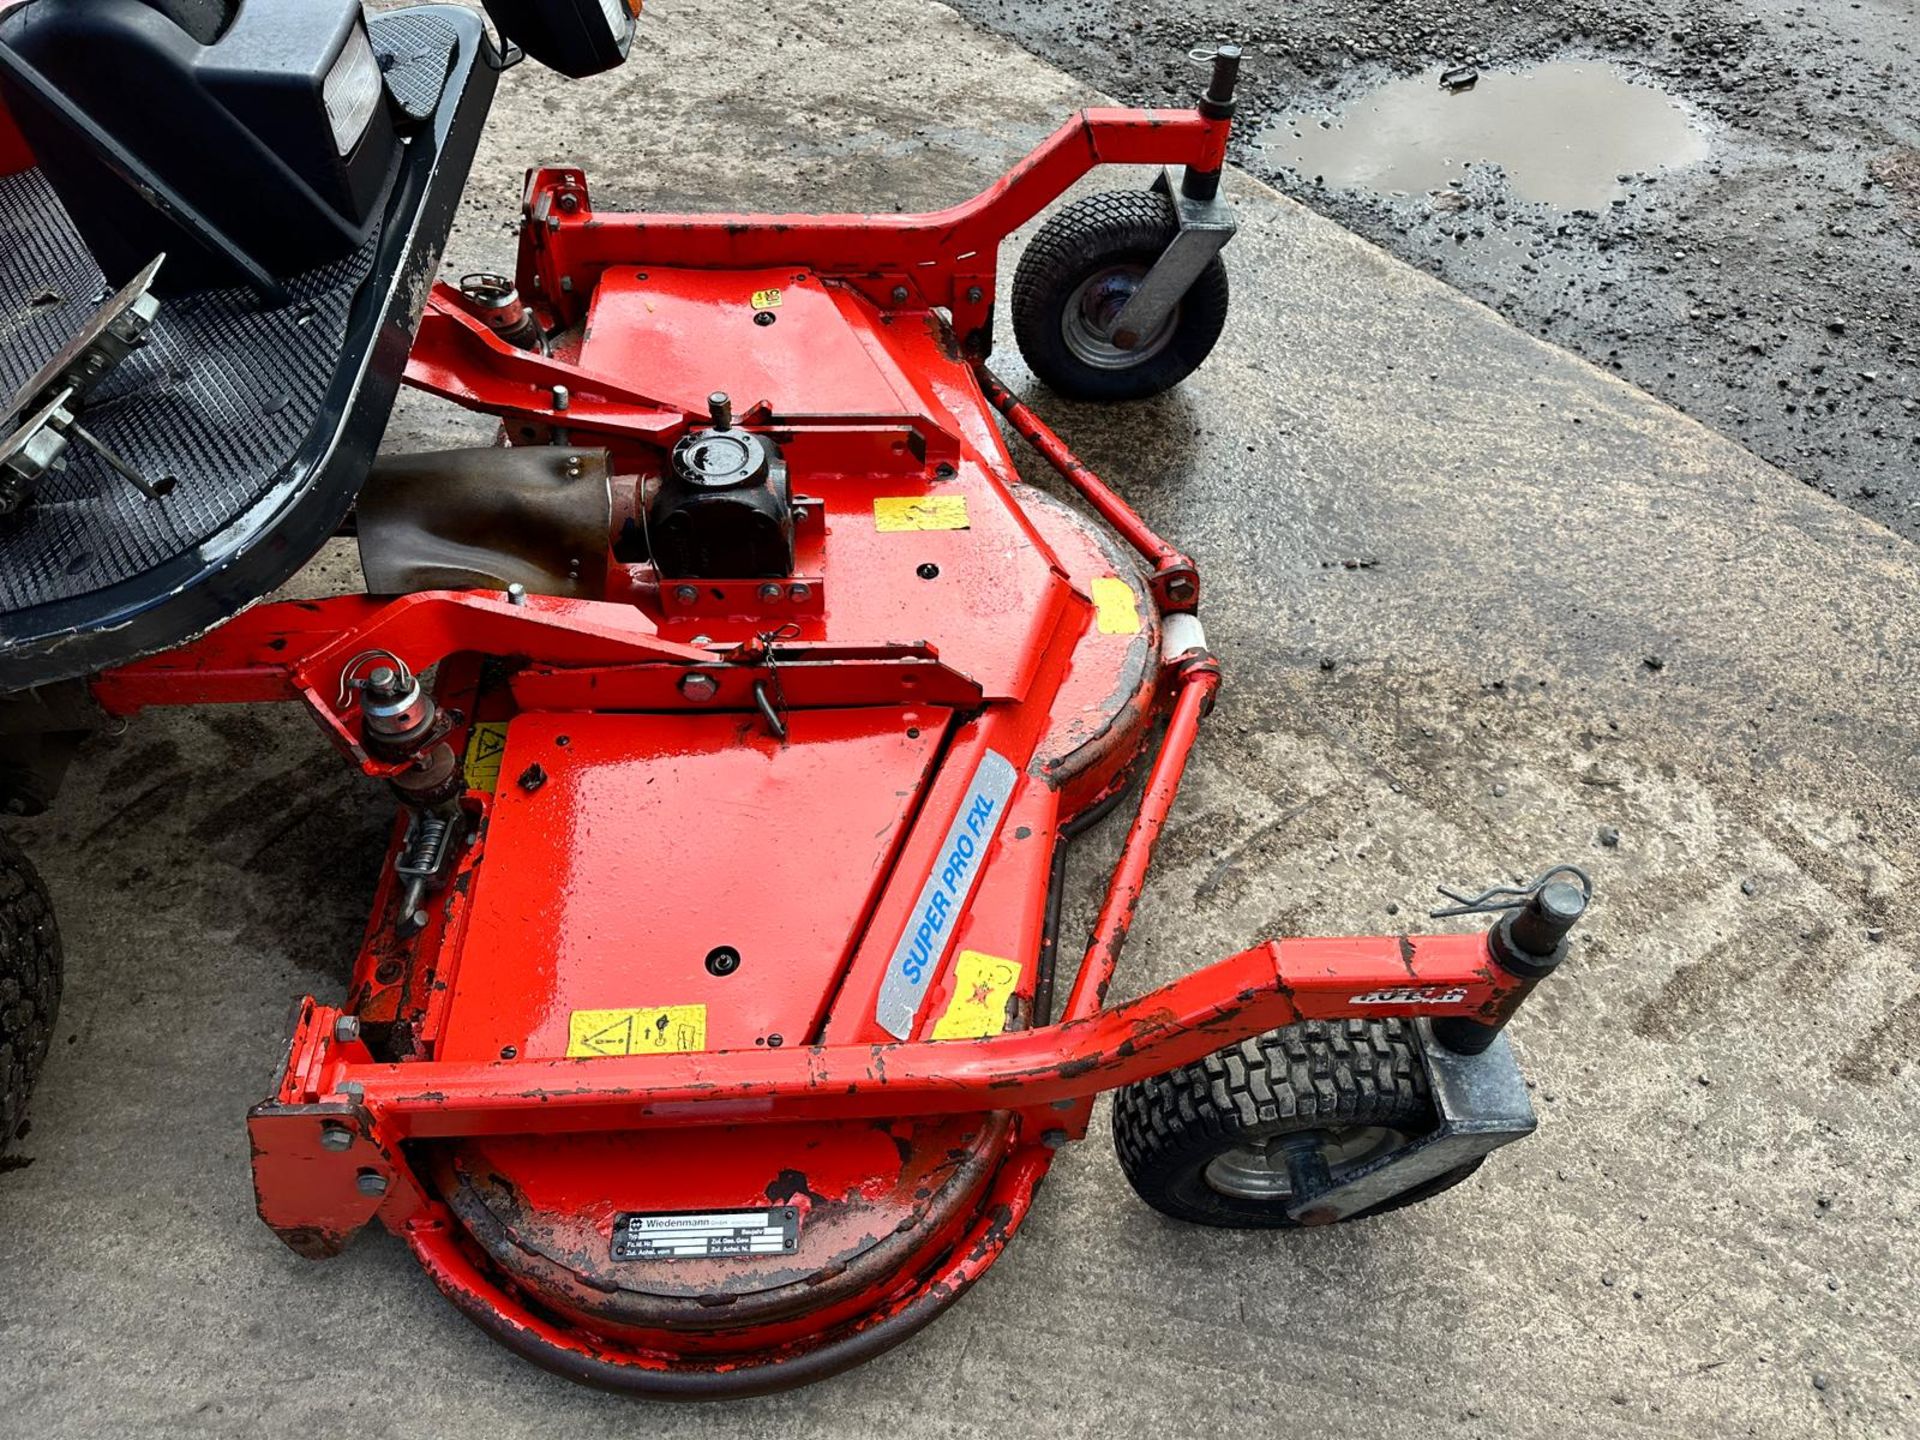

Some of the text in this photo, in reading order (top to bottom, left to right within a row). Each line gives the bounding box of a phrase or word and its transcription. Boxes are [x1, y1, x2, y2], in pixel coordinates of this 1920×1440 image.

[902, 793, 995, 985] SUPER PRO FXL
[646, 1218, 710, 1228] Wiedenmann
